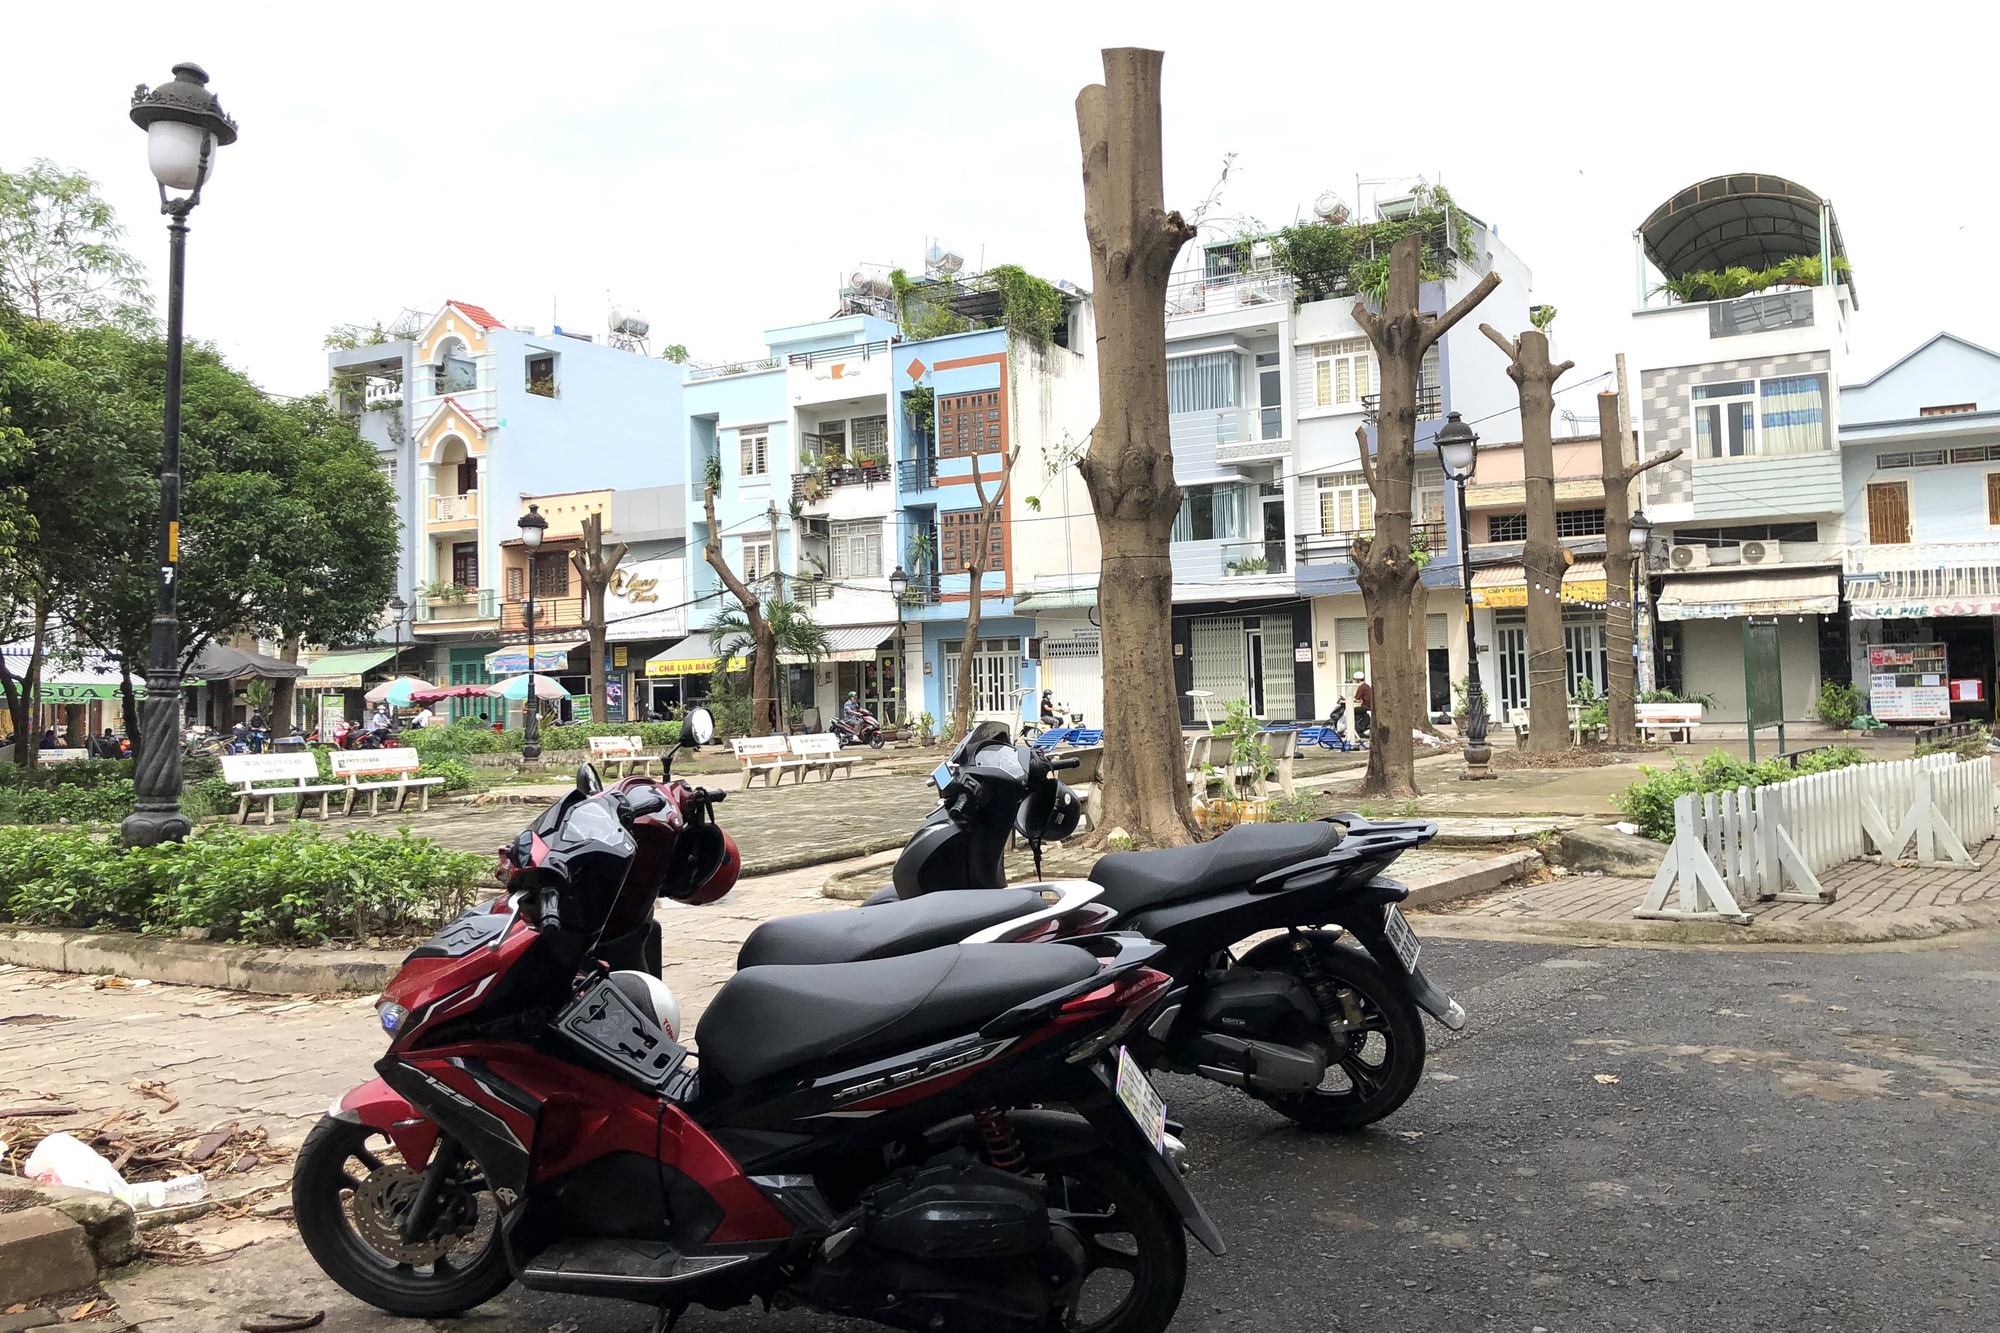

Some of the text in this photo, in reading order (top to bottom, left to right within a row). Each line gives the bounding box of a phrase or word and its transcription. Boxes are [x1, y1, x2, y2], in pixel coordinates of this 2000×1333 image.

[161, 566, 174, 584] 7
[1900, 605, 1929, 616] PHÊ
[659, 662, 675, 673] CHẢ
[832, 1047, 985, 1100] AIR BLADE
[425, 1075, 476, 1107] 125
